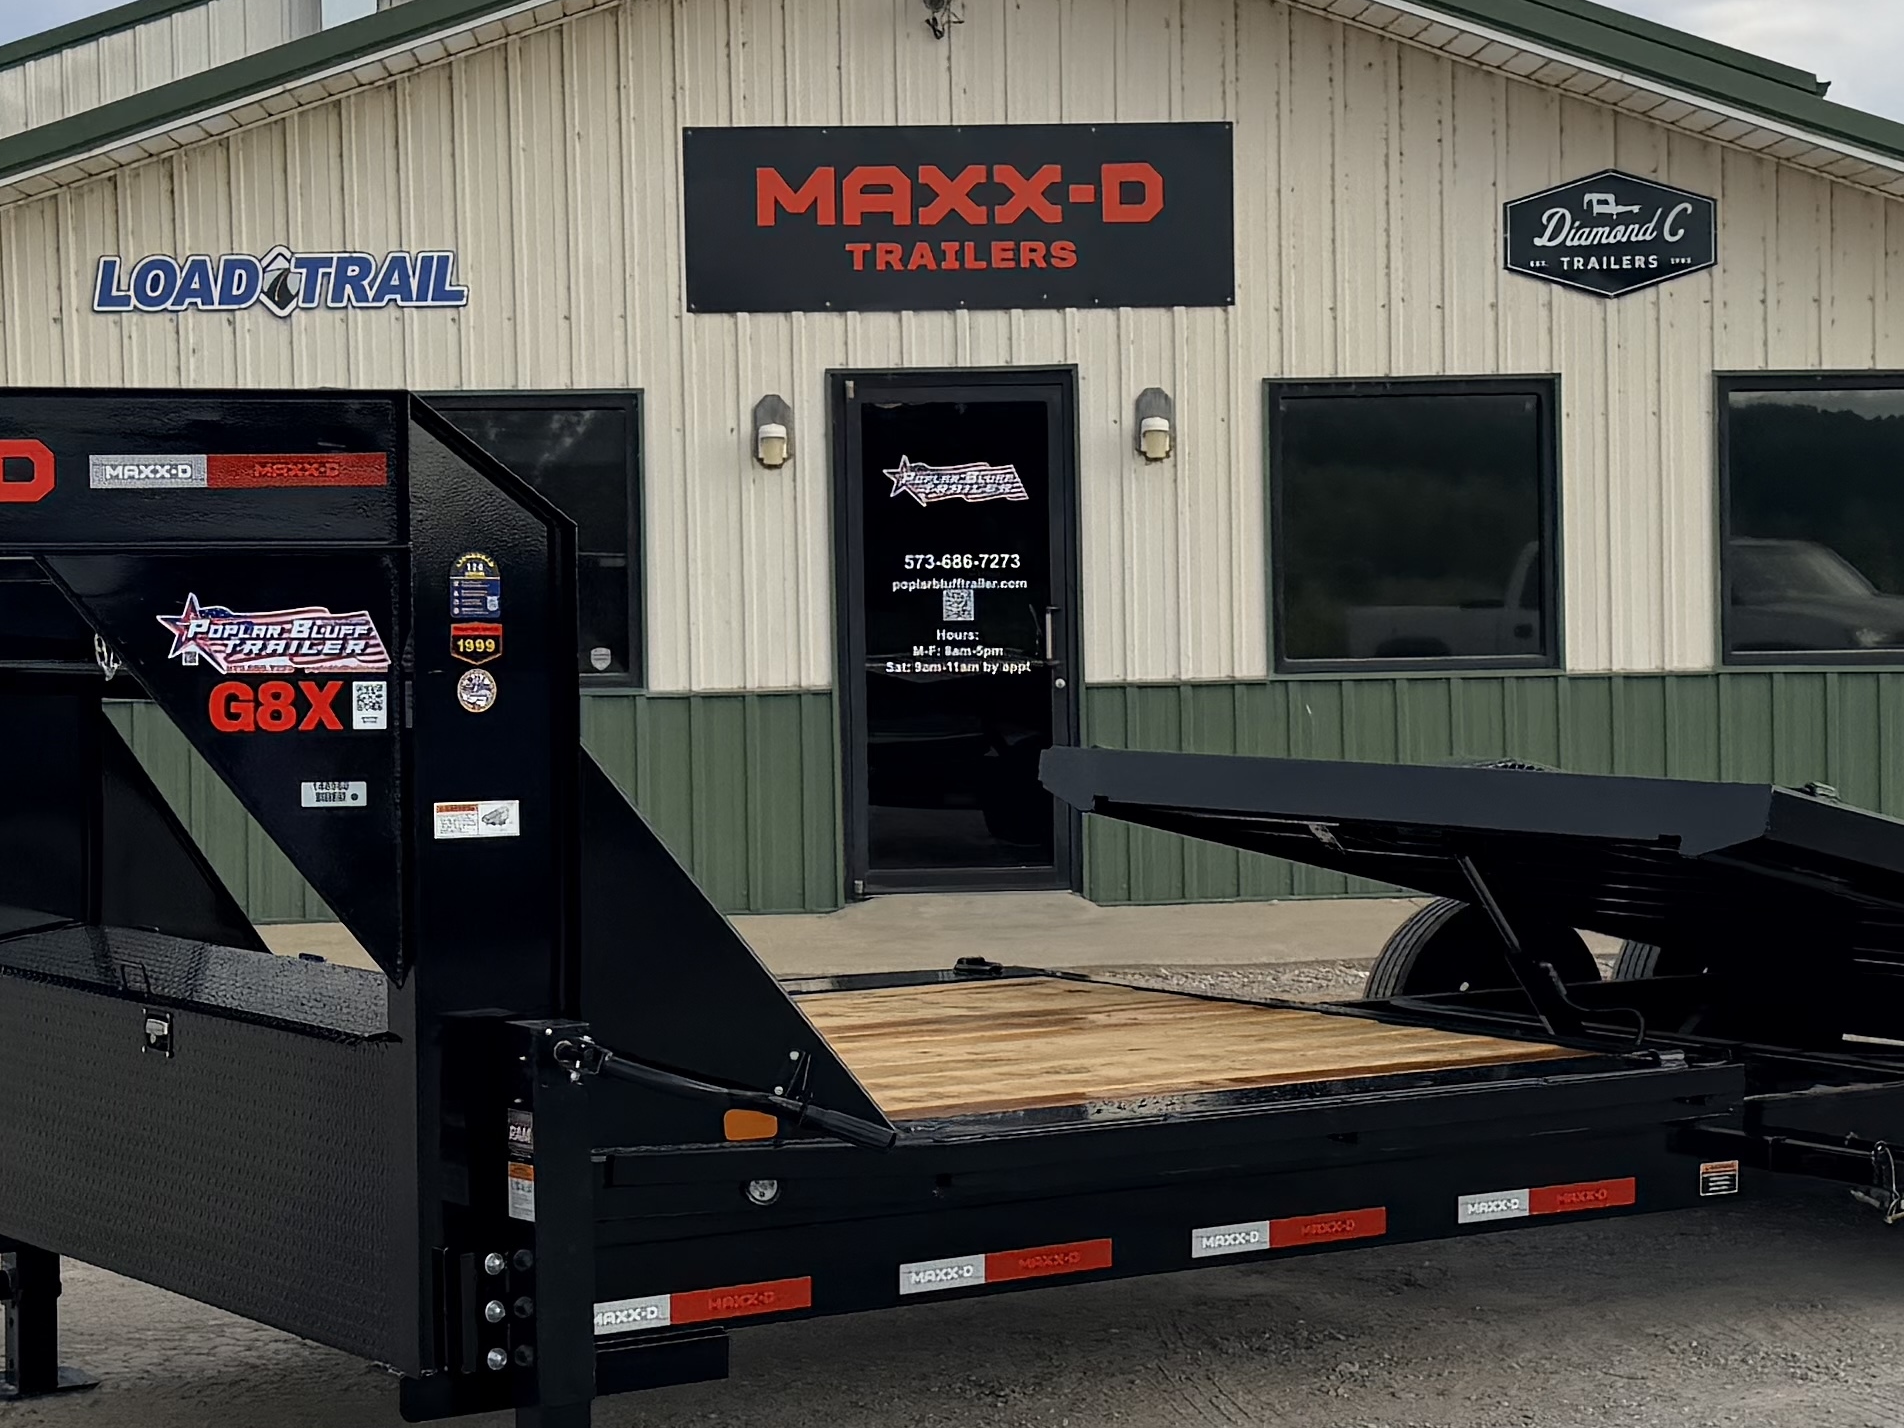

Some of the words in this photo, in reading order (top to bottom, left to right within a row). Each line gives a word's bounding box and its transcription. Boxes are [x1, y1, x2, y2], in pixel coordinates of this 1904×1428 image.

[756, 162, 1164, 227] MAXX-D
[1533, 207, 1662, 247] Diamond
[1662, 202, 1693, 243] C
[845, 240, 1077, 271] TRAILERS
[1560, 255, 1658, 270] TRAILERS
[93, 254, 263, 312] LOAD
[291, 251, 468, 308] TRAIL
[105, 464, 192, 479] MAXX-D
[254, 462, 340, 478] MAXX-D
[904, 554, 1021, 569] 573-686-7273
[892, 578, 1028, 592] poplarblufftrailer.com
[187, 619, 281, 639] POPLAR
[291, 619, 369, 639] BLUFF
[936, 629, 979, 640] Hours:
[225, 640, 367, 654] TRAILER
[457, 638, 495, 653] 1999
[912, 646, 941, 656] M-F:
[886, 661, 911, 673] Sat:
[982, 662, 998, 674] by
[208, 680, 345, 733] G8X
[1467, 1197, 1520, 1214] MAXX-D
[1556, 1187, 1608, 1205] MAXX-D
[1201, 1230, 1259, 1249] MAXX-D
[910, 1264, 974, 1284] MAXX-D
[1018, 1251, 1081, 1269] MAXX-D
[708, 1291, 775, 1311] MAXX-D
